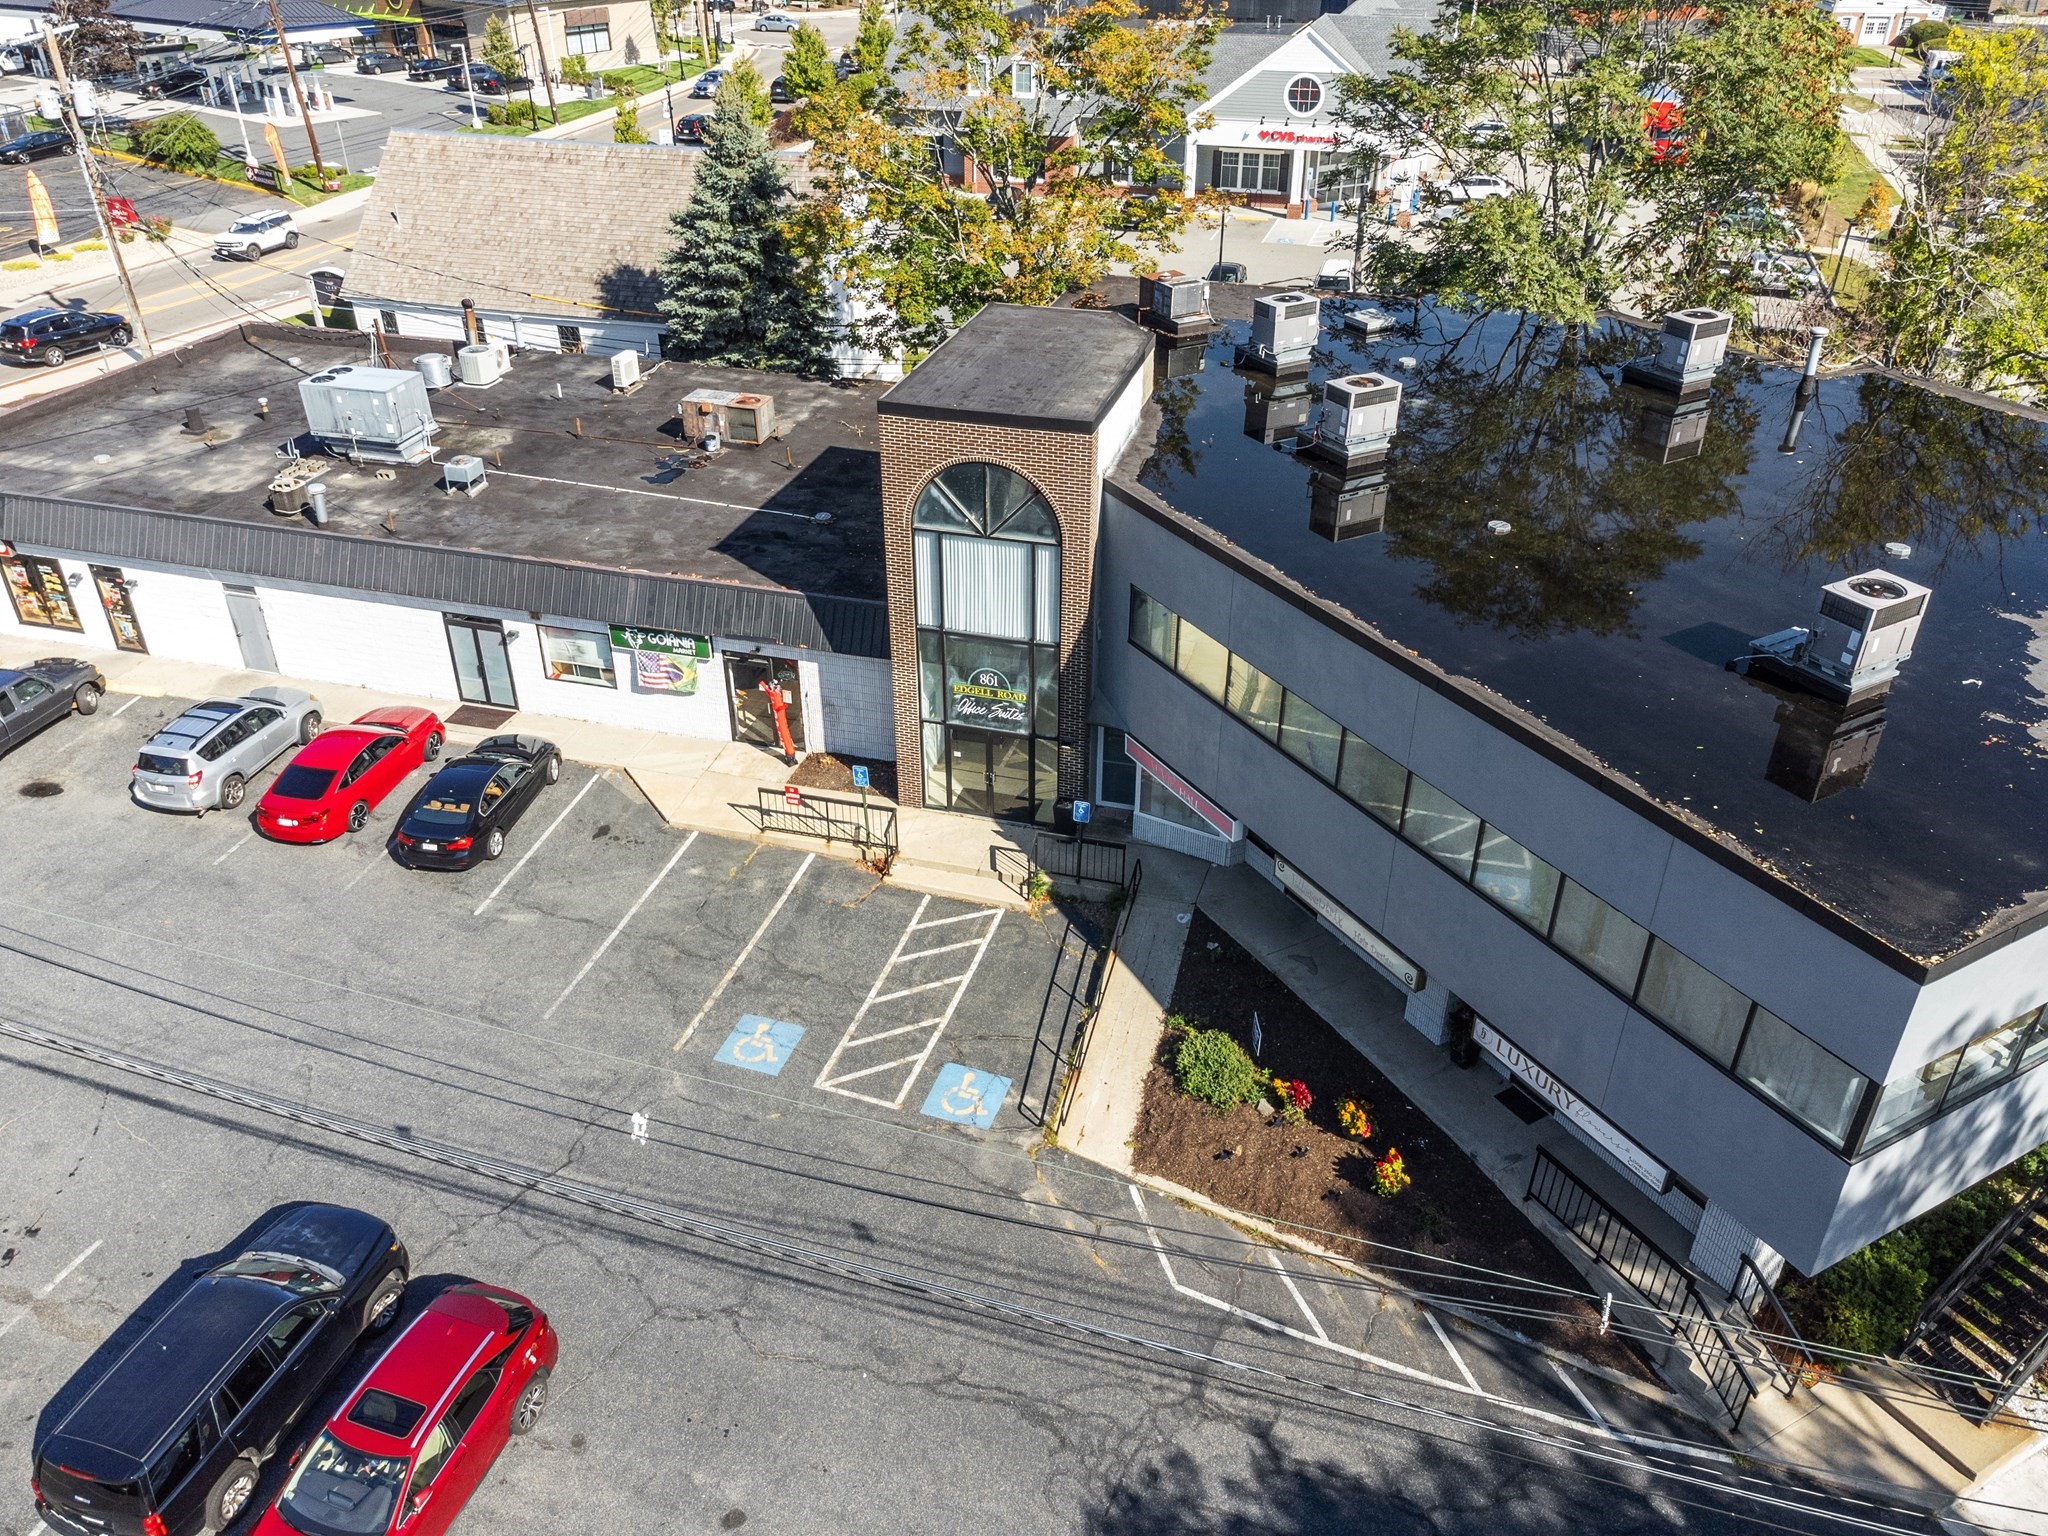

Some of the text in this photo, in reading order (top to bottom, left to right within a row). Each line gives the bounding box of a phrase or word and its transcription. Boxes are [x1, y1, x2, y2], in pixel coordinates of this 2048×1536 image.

[1271, 131, 1295, 142] CVS
[672, 647, 696, 656] MARKET
[979, 673, 998, 687] 861
[953, 684, 1027, 701] EDGELL ROAD
[957, 698, 1026, 721] Office Suites
[1496, 1038, 1631, 1153] LUXURY flowers
